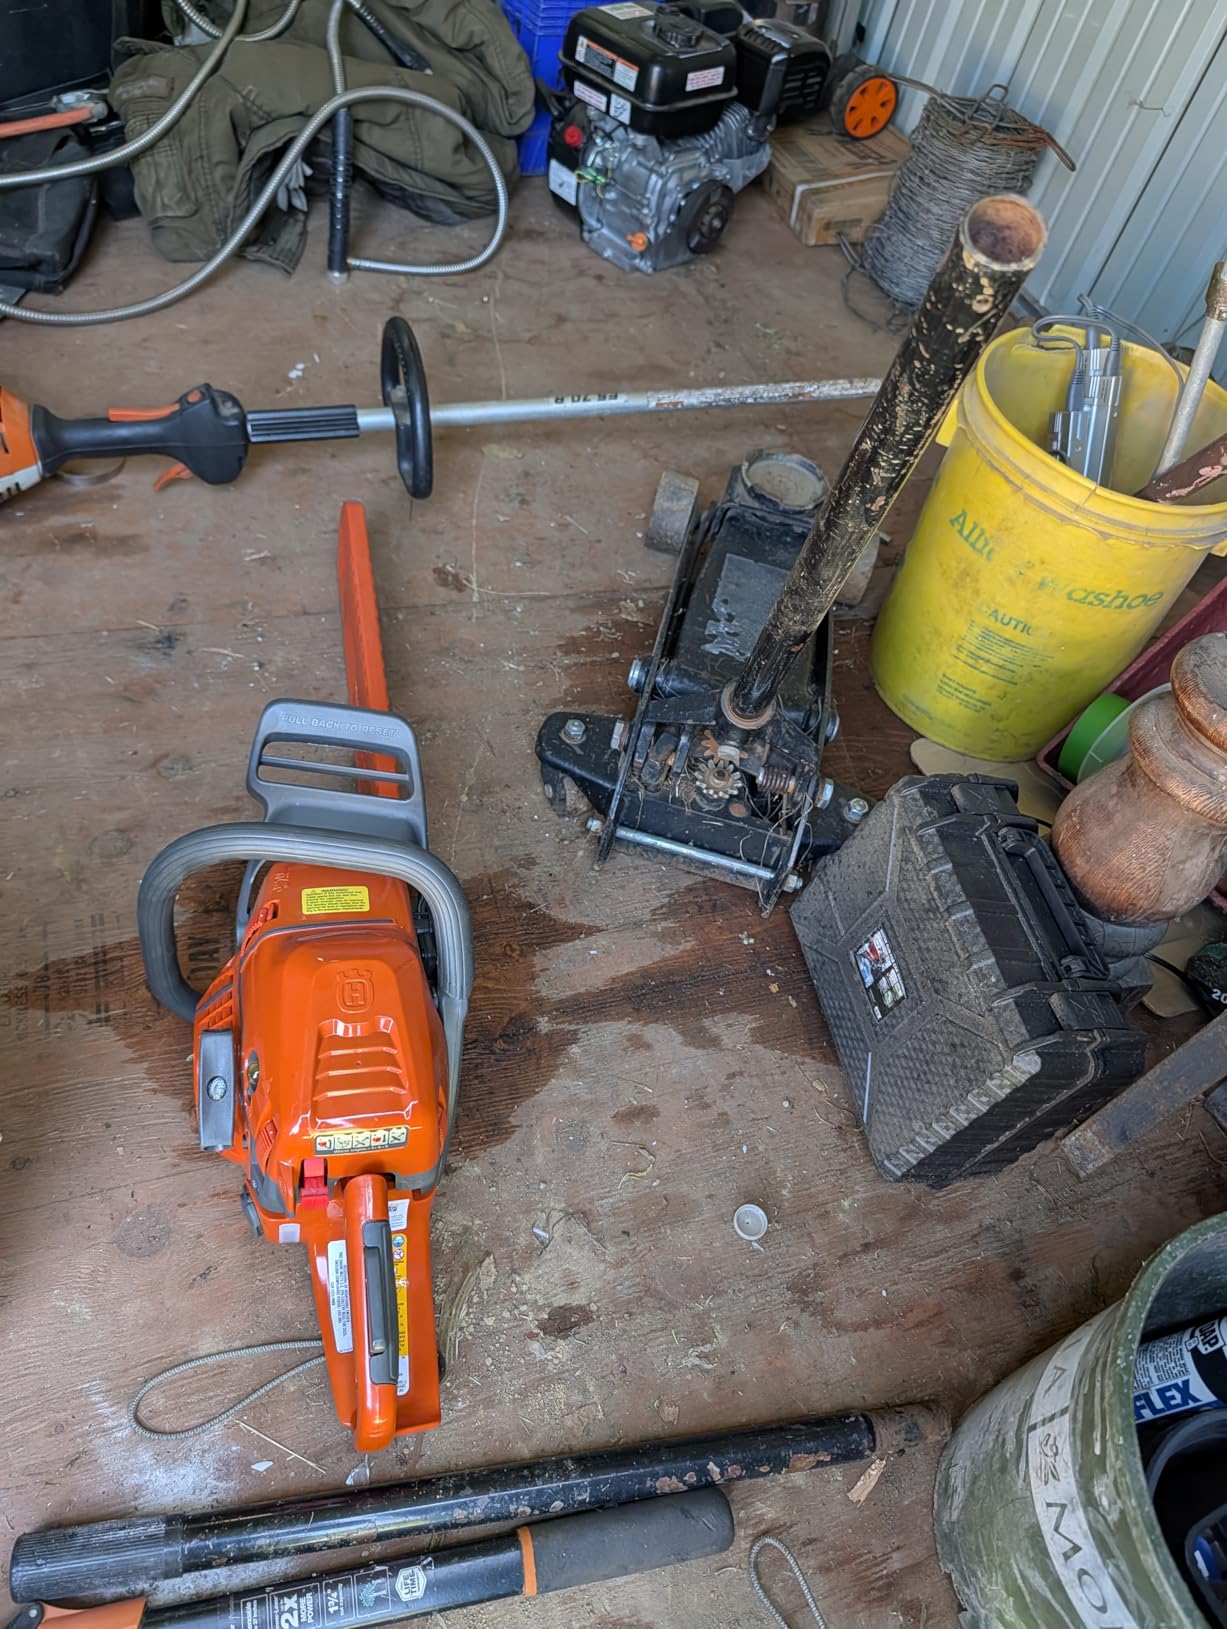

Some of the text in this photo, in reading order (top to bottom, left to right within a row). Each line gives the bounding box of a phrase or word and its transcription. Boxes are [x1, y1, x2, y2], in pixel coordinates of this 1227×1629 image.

[1038, 576, 1165, 610] ashoe
[311, 718, 340, 729] BACK
[345, 723, 358, 732] TO
[362, 726, 397, 737] RESET
[1046, 1502, 1124, 1629] MO
[306, 1592, 314, 1623] POWER
